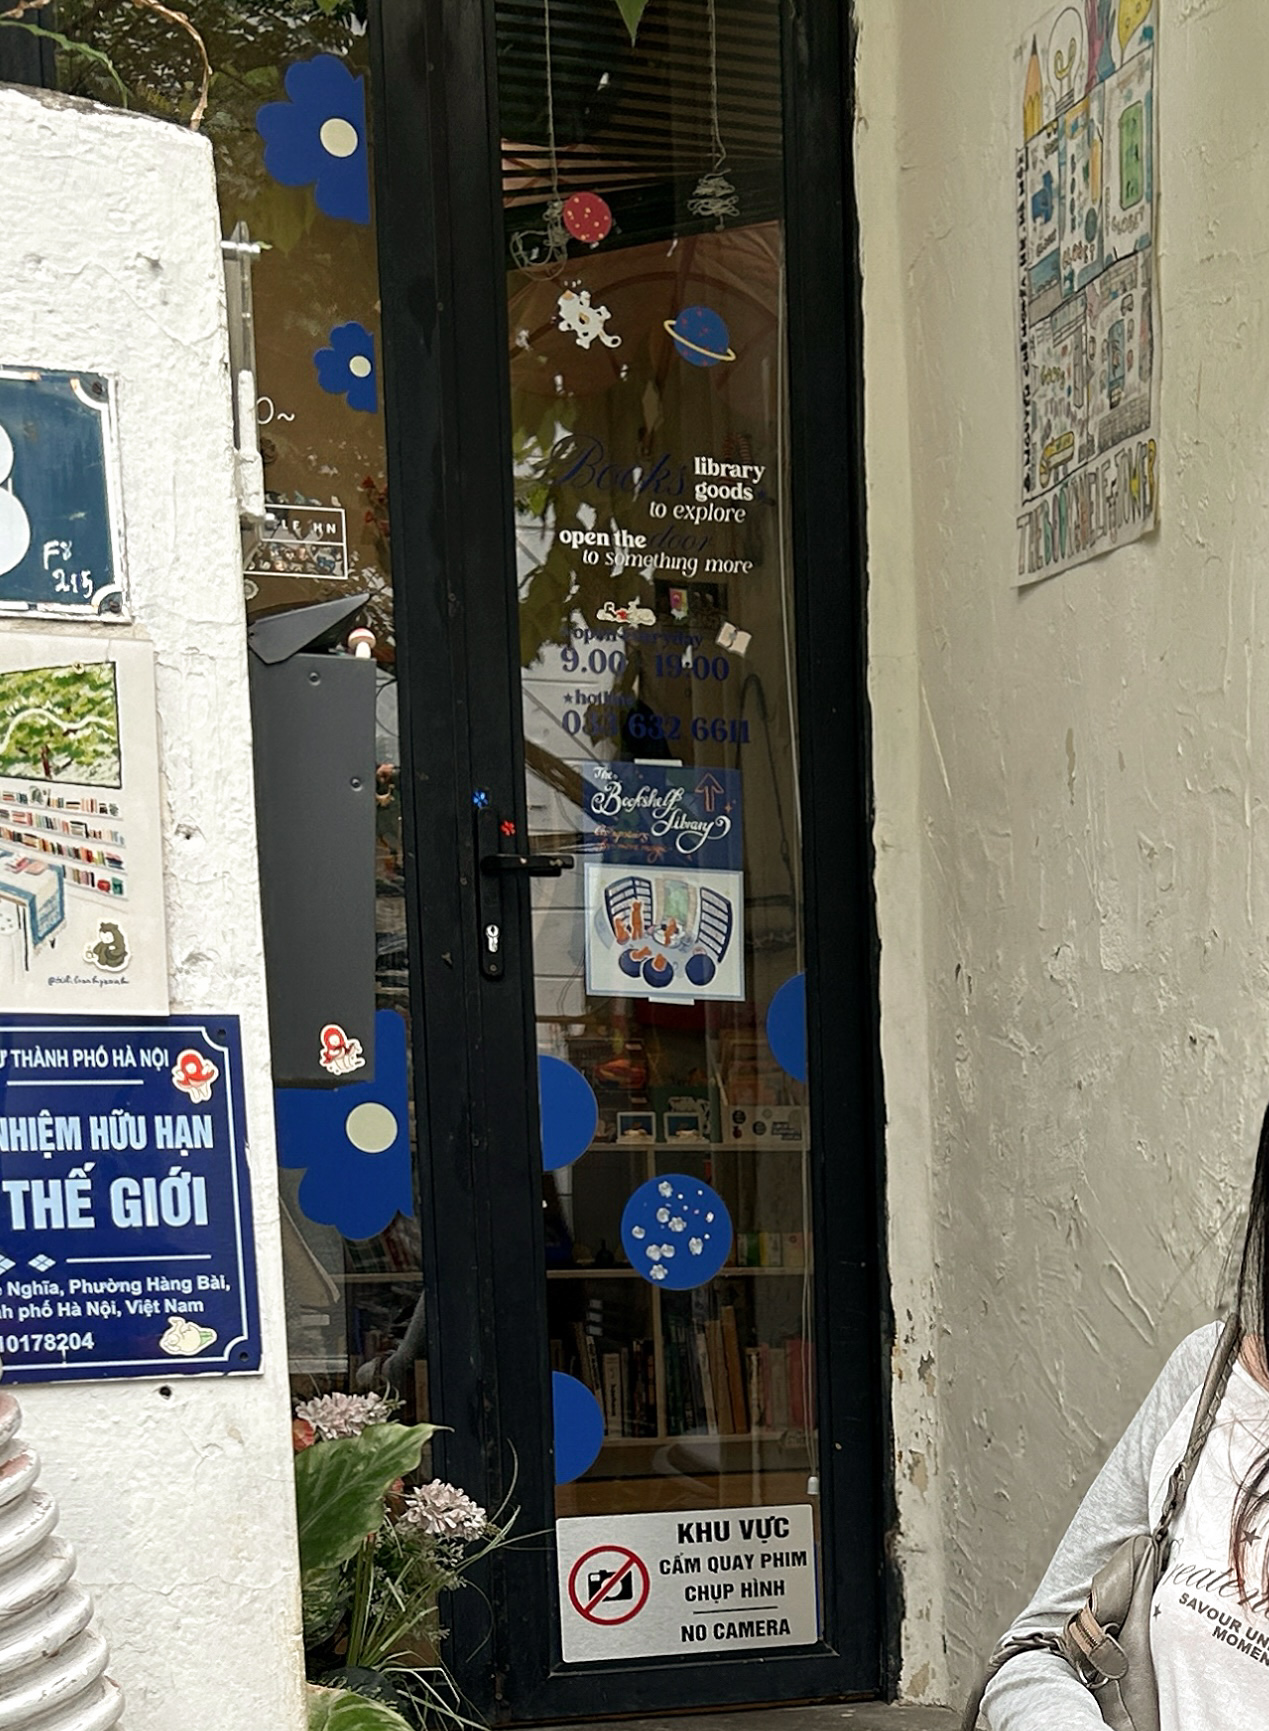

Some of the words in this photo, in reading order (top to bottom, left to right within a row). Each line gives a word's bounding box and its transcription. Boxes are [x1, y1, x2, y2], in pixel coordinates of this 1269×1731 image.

[693, 456, 766, 484] library
[694, 481, 754, 502] goods
[649, 501, 667, 519] to
[673, 502, 746, 525] explore
[559, 529, 610, 549] open
[613, 529, 647, 549] the
[583, 550, 599, 566] to
[604, 552, 698, 578] something
[705, 557, 753, 574] more
[561, 648, 626, 675] 9.00
[628, 712, 681, 740] 632
[593, 766, 616, 780] The
[590, 781, 685, 819] Bookshelf
[651, 808, 732, 855] Library
[11, 1045, 69, 1068] THÀNH
[72, 1044, 109, 1068] PHỐ
[112, 1044, 137, 1068] HÀ
[139, 1046, 169, 1072] NỘI
[89, 1108, 147, 1150] HỮU
[154, 1114, 214, 1157] HẠN
[3, 1161, 96, 1231] THẾ
[110, 1165, 209, 1229] GIỚI
[69, 1278, 143, 1296] Phường
[146, 1276, 193, 1293] Hàng
[18, 1300, 53, 1322] phố
[57, 1301, 82, 1318] Hà
[86, 1301, 122, 1320] Nội,
[125, 1299, 160, 1317] Việt
[164, 1298, 205, 1313] Nam
[677, 1520, 730, 1544] KHU
[738, 1515, 790, 1544] VỰC
[659, 1552, 701, 1575] CẤM
[707, 1554, 756, 1574] QUAY
[761, 1551, 807, 1568] PHIM
[684, 1583, 735, 1604] CHỤP
[740, 1578, 785, 1598] HÌNH
[1178, 1592, 1243, 1634] SAVOUR
[681, 1624, 707, 1642] NO
[713, 1619, 791, 1640] CAMERA
